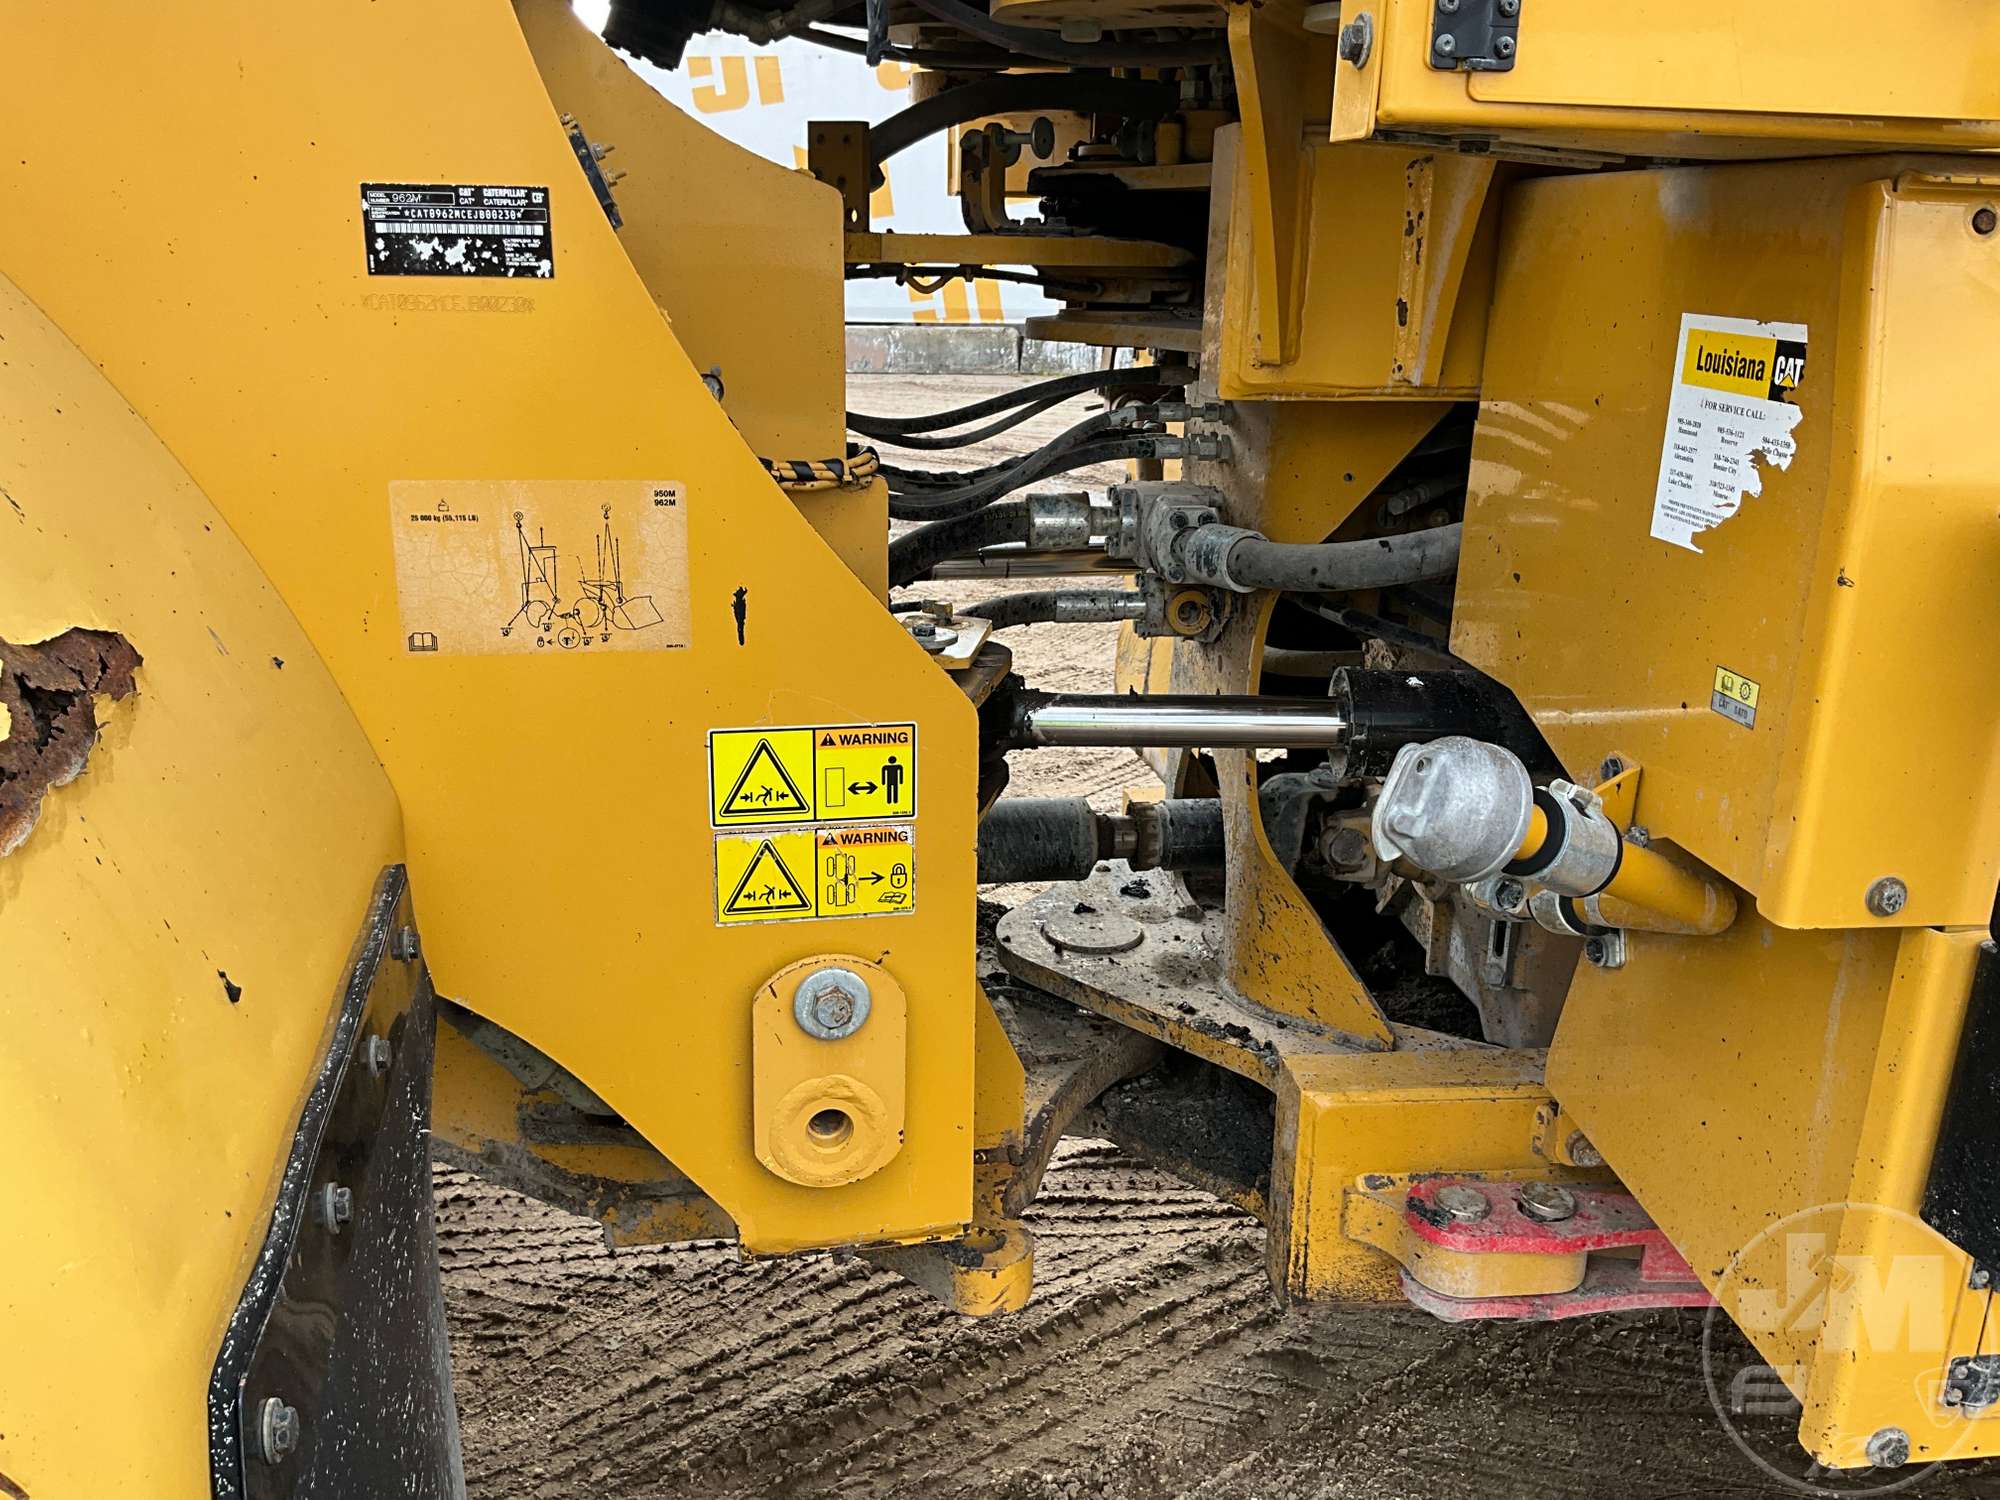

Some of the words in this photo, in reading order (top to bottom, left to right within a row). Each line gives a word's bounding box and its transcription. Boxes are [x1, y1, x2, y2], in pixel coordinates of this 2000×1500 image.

[1696, 345, 1766, 382] Louisiana
[1774, 355, 1805, 388] CAT
[1704, 399, 1719, 411] FOR
[1718, 401, 1745, 415] SERVICE
[1745, 407, 1767, 420] CALL:
[654, 489, 676, 498] 950M
[654, 499, 676, 507] 962M
[433, 514, 441, 523] kg
[839, 732, 909, 746] WARNING
[840, 831, 909, 845] WARNING
